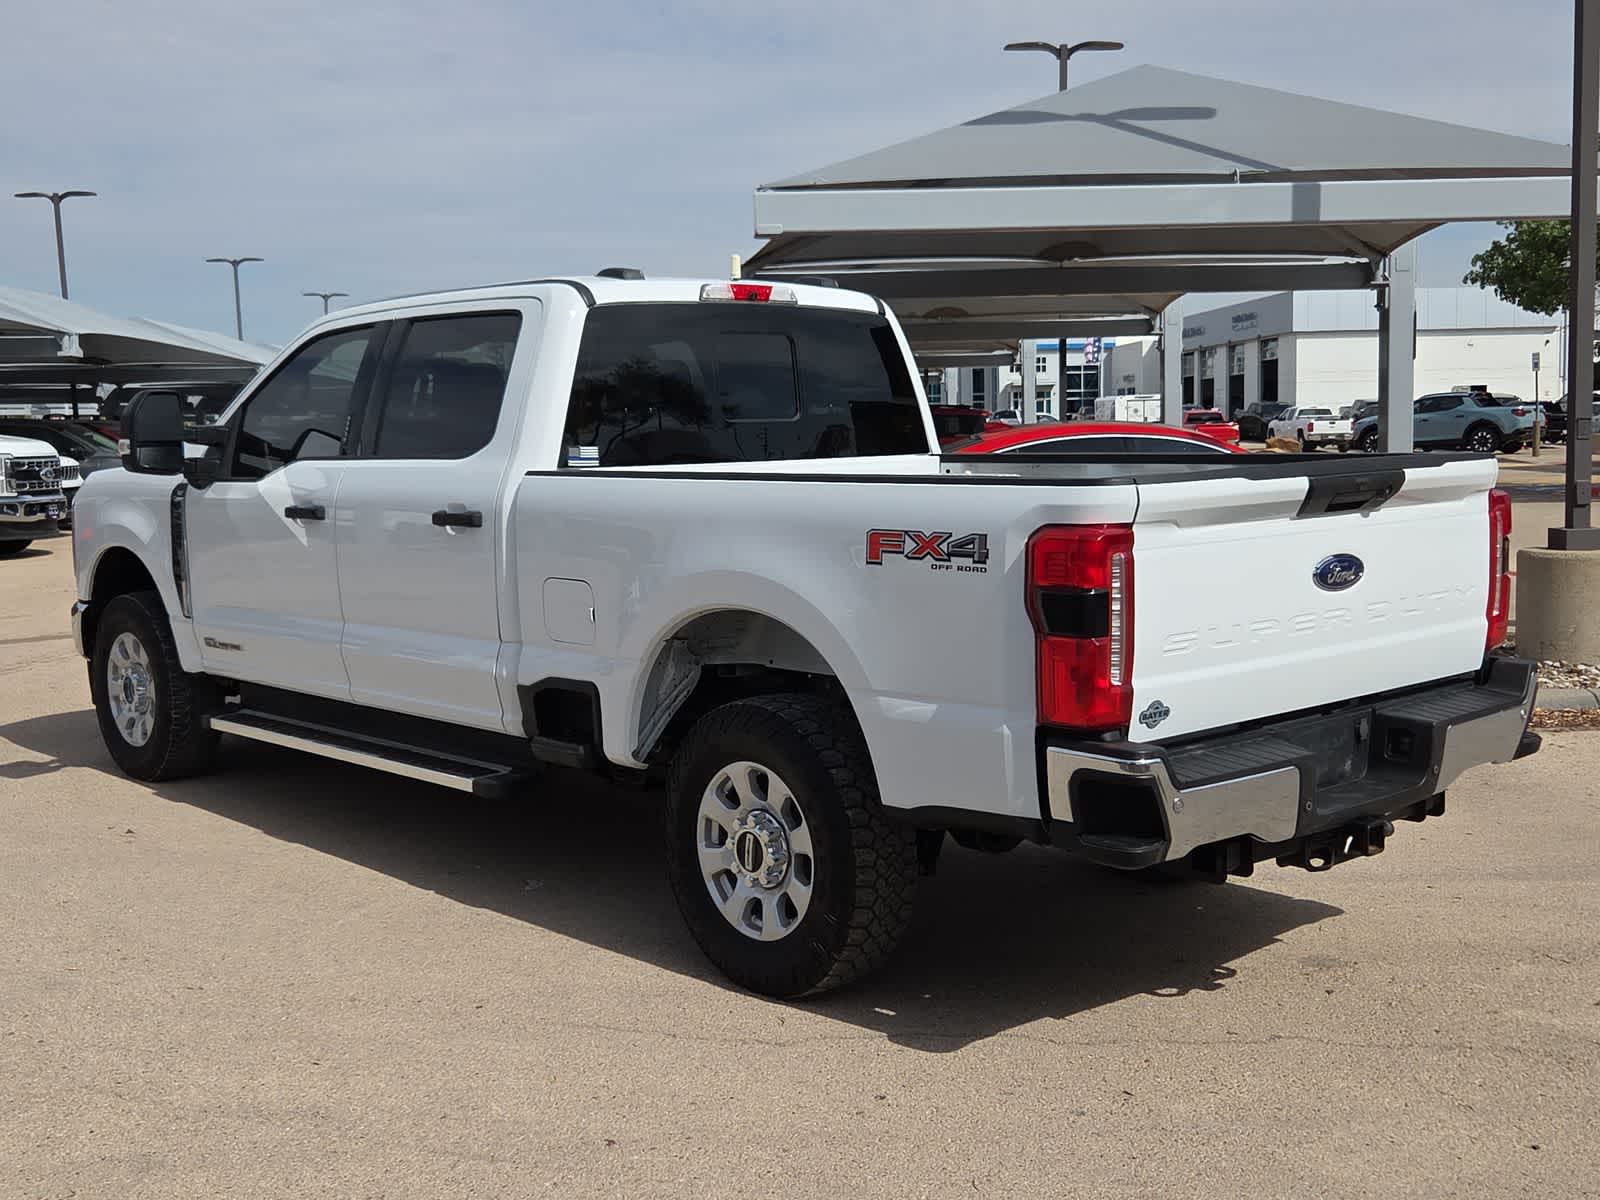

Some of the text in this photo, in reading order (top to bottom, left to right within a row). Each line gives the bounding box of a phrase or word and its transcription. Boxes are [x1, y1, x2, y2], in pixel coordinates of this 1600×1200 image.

[865, 528, 989, 566] FX4
[931, 563, 988, 574] OFF ROAD
[1327, 562, 1356, 584] Ford
[1161, 584, 1476, 657] SUPER DUTY
